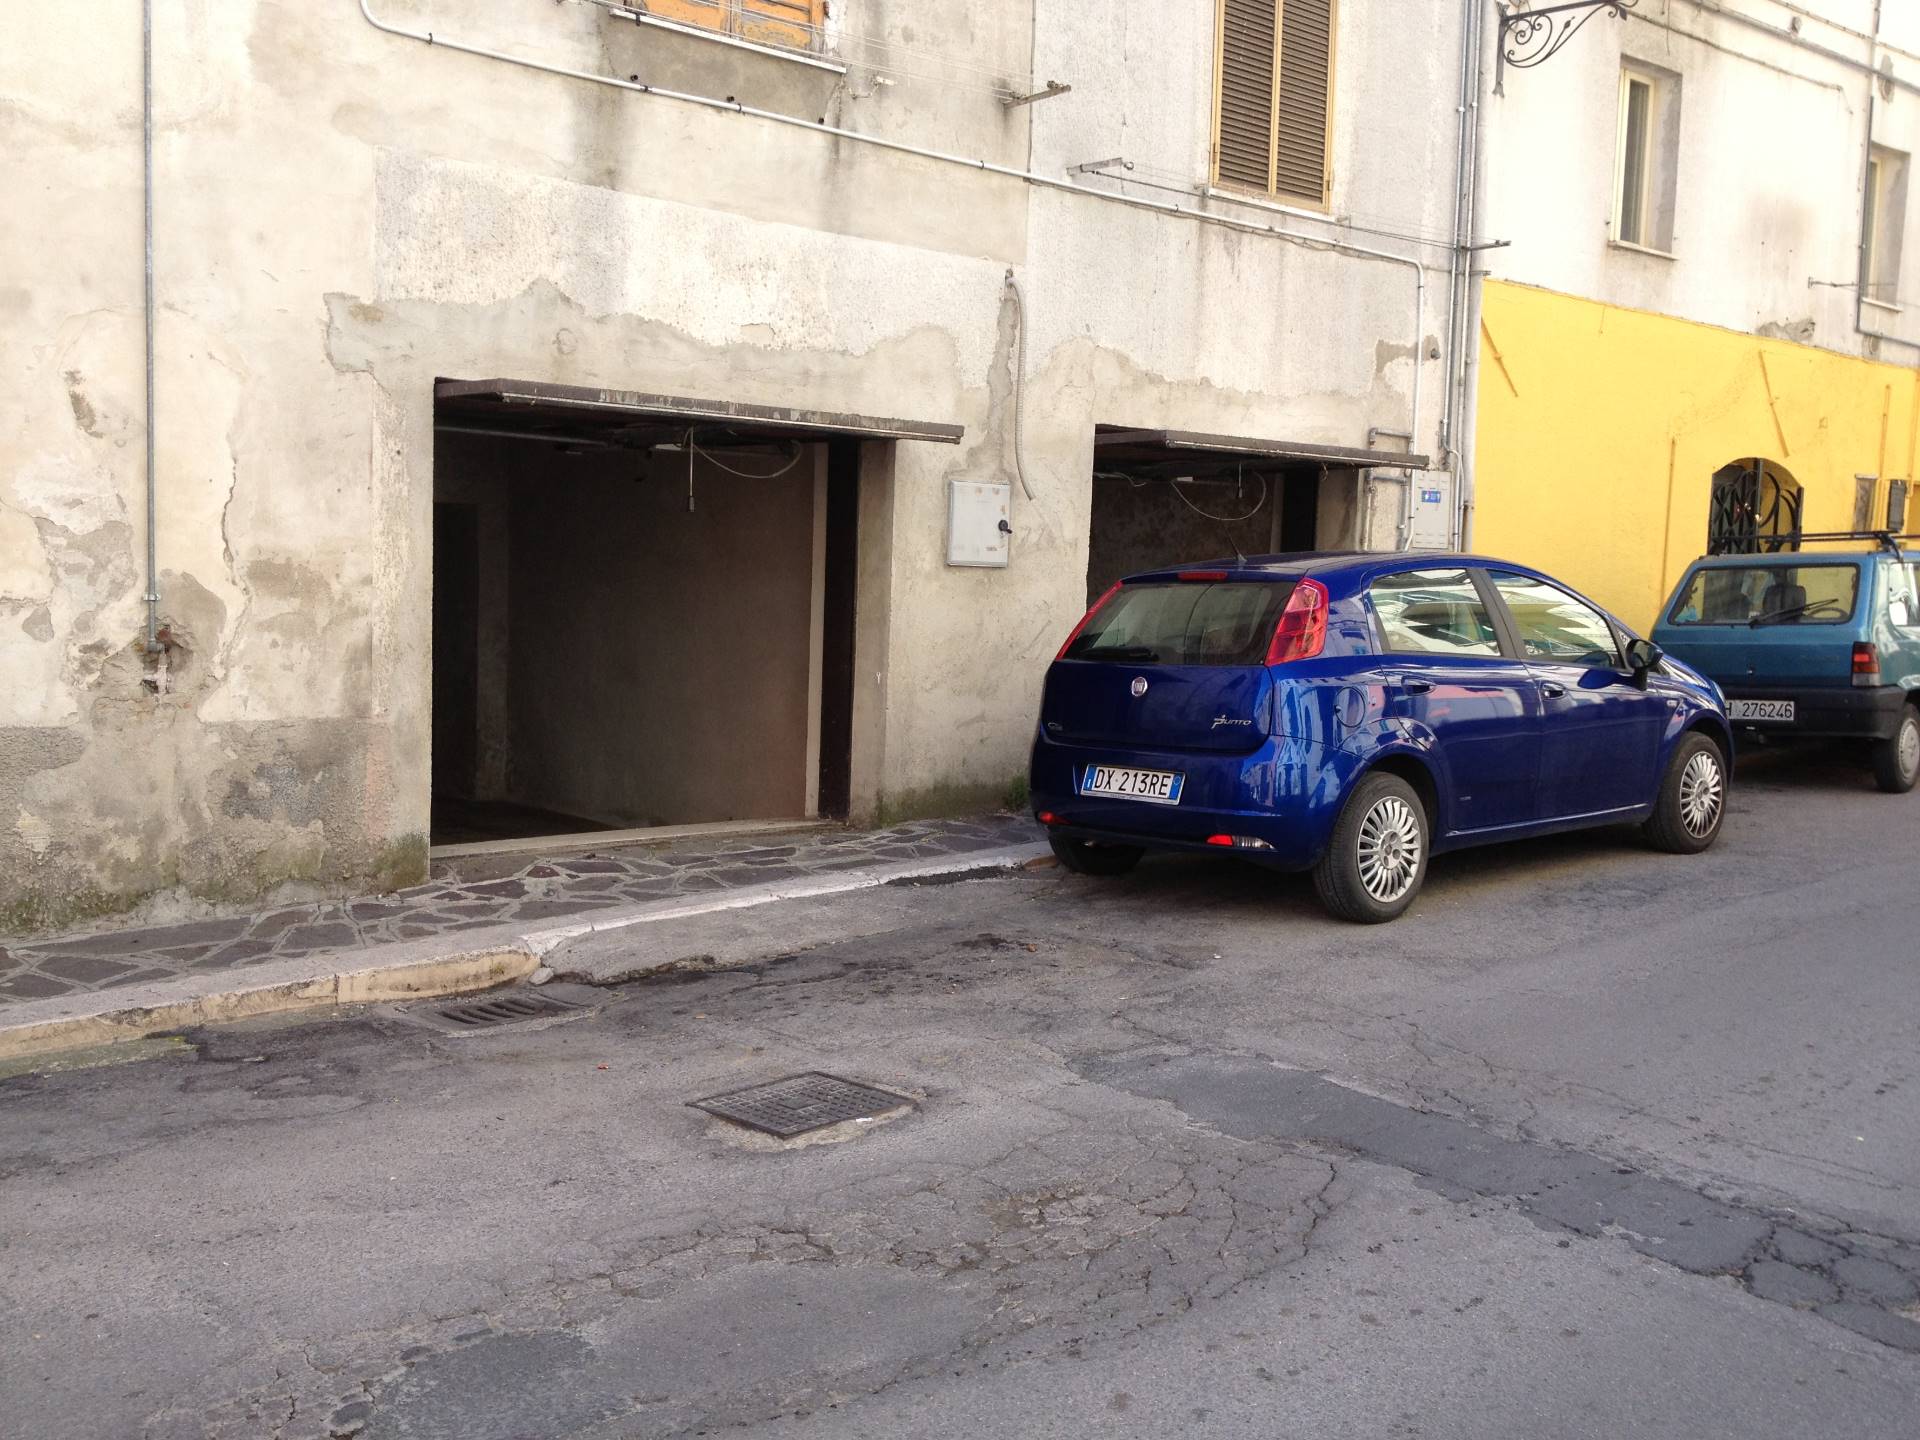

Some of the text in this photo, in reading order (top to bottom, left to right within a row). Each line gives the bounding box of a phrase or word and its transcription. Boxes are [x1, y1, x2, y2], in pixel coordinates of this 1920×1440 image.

[1742, 702, 1793, 718] 276246
[1094, 769, 1115, 790] DX
[1118, 771, 1171, 796] 213RE
